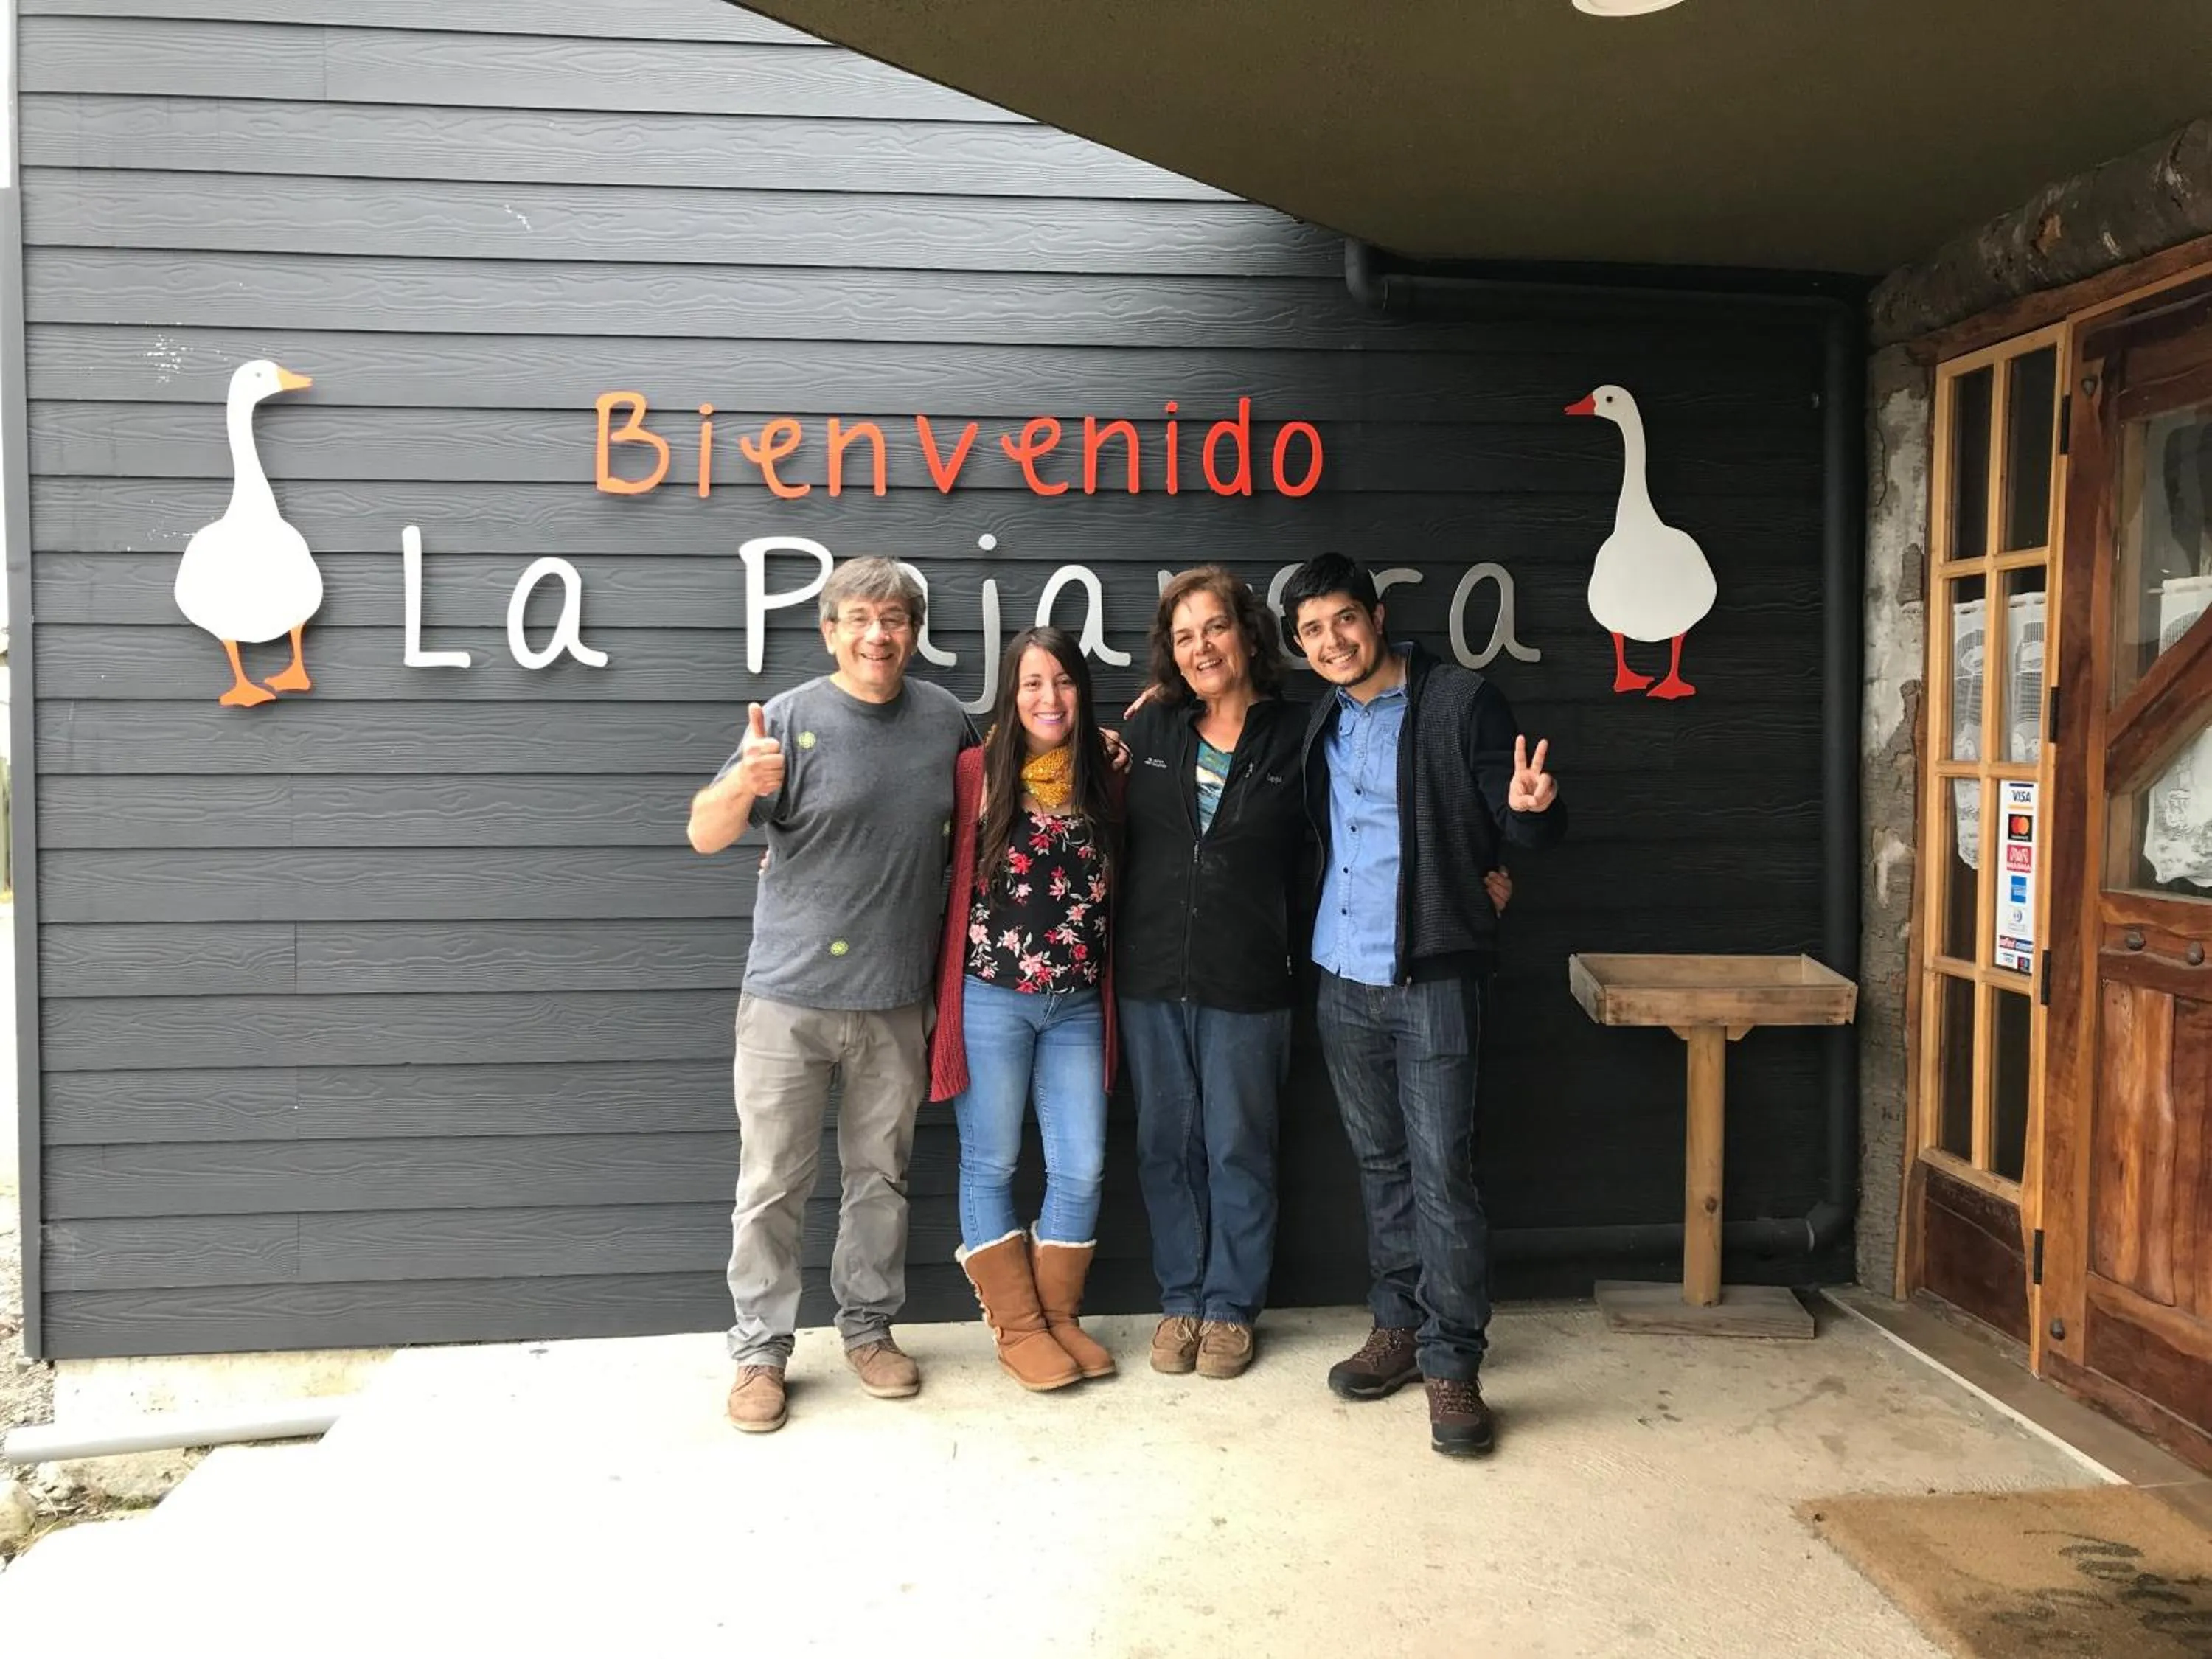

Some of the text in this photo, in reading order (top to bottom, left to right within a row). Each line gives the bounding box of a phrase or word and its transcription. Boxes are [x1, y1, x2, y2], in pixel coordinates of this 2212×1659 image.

[595, 392, 1324, 500] Bienvenido
[402, 525, 1541, 714] La Pjaa
[2011, 790, 2032, 803] VISA
